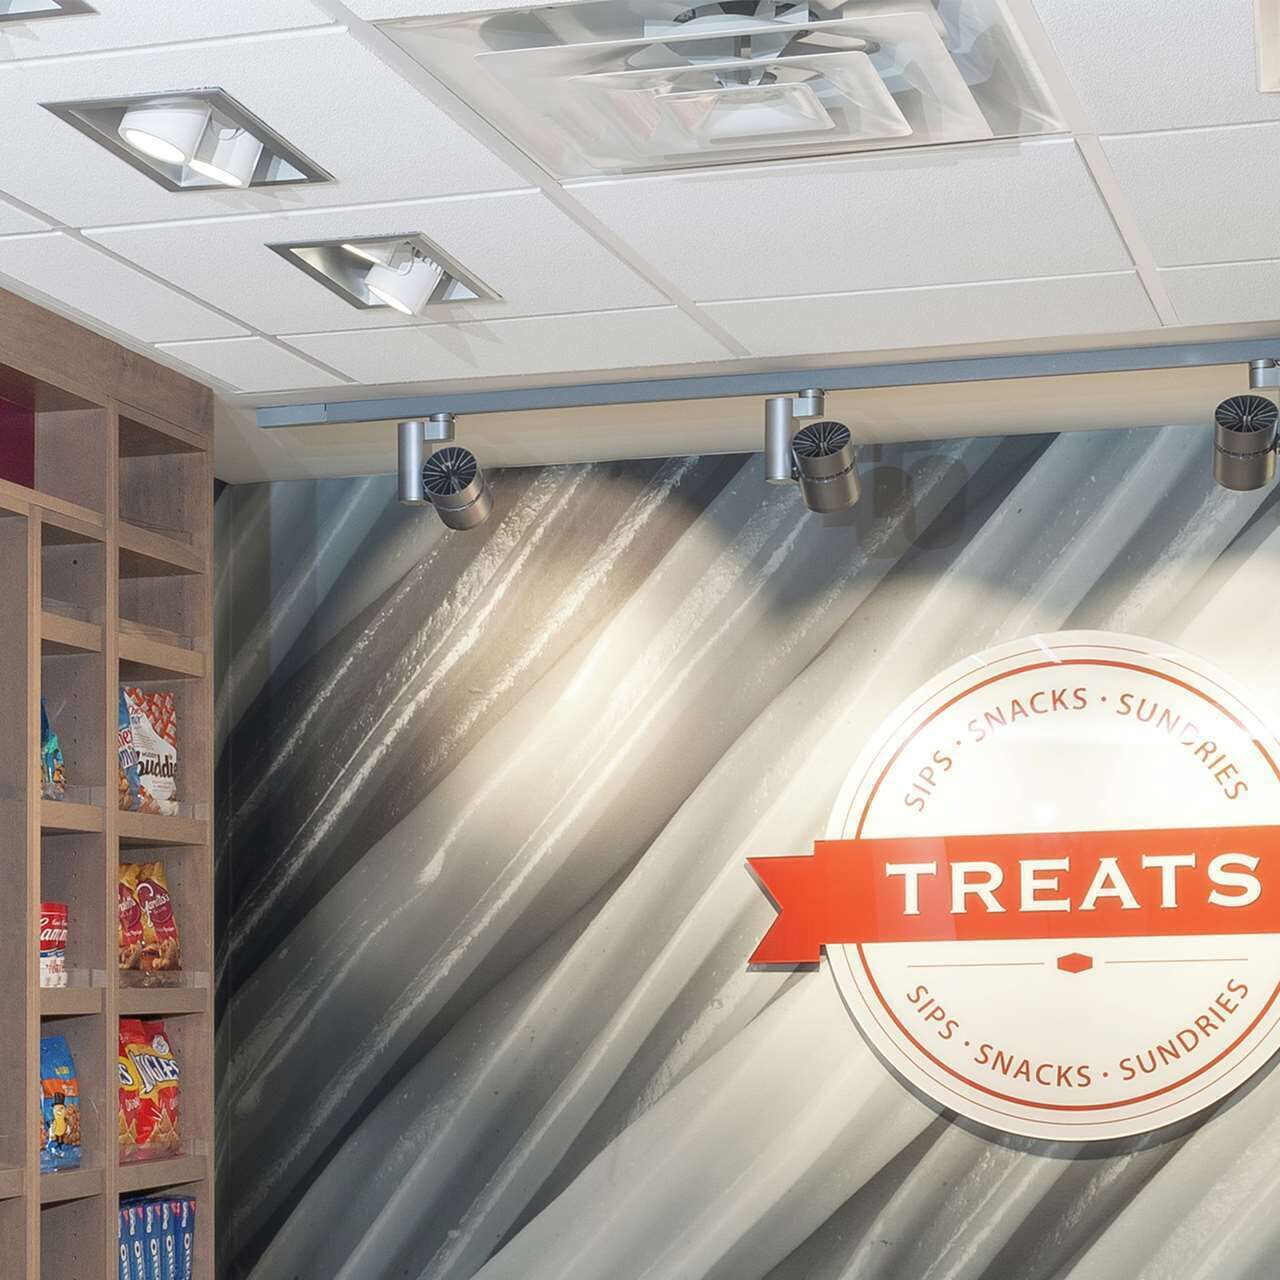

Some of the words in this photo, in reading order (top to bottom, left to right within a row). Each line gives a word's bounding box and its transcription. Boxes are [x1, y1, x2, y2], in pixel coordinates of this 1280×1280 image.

[903, 749, 954, 813] SIPS
[966, 686, 1089, 743] SNACKS
[1118, 691, 1250, 802] SUNDRIES
[884, 852, 1264, 917] TREATS
[905, 984, 955, 1042] SIPS
[973, 1042, 1092, 1089] SNACKS
[1118, 976, 1251, 1082] SUNDRIES
